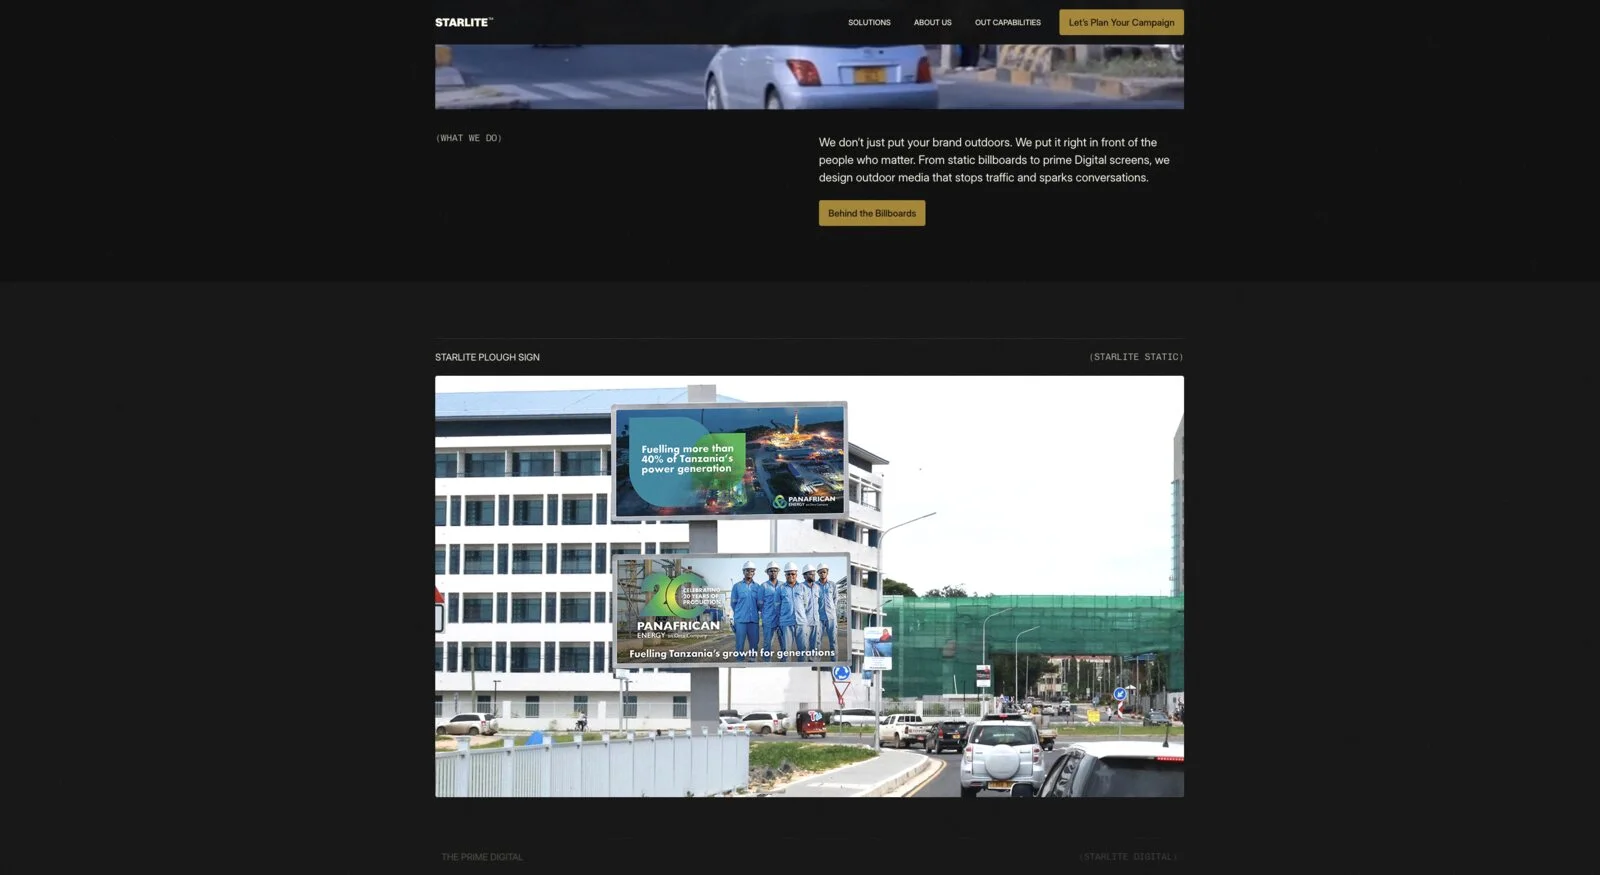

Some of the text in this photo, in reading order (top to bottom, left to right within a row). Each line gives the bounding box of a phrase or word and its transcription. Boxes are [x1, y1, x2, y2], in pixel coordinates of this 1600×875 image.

[848, 18, 892, 27] SOLUTIONS
[913, 18, 953, 27] ABOUT US
[974, 18, 1042, 27] OUT CAPABILITIES
[1068, 17, 1175, 29] Let's Plan Your Campaign
[436, 133, 502, 143] (WHAT WE DO)
[818, 137, 1158, 150] We don't just put your brand outdoors. We put it right in front of the
[818, 154, 1171, 168] people who matter. From static billboards to prime Digital screens, we
[818, 172, 1149, 185] design outdoor media that stops traffic and sparks conversations.
[828, 208, 917, 218] Behind the Billboards
[435, 352, 540, 362] STARLITE PLOUGH SIGN
[1089, 352, 1183, 362] (STARLITE STATIC)
[641, 444, 680, 454] Fuelling
[712, 443, 734, 453] than
[641, 454, 734, 464] 40% of Tanzania's
[641, 464, 732, 476] power generation
[637, 621, 720, 631] PANAFRICAN
[629, 649, 835, 659] Fuelling Tanzania's growth for generations
[441, 852, 523, 862] THE PRIME DIGITAL
